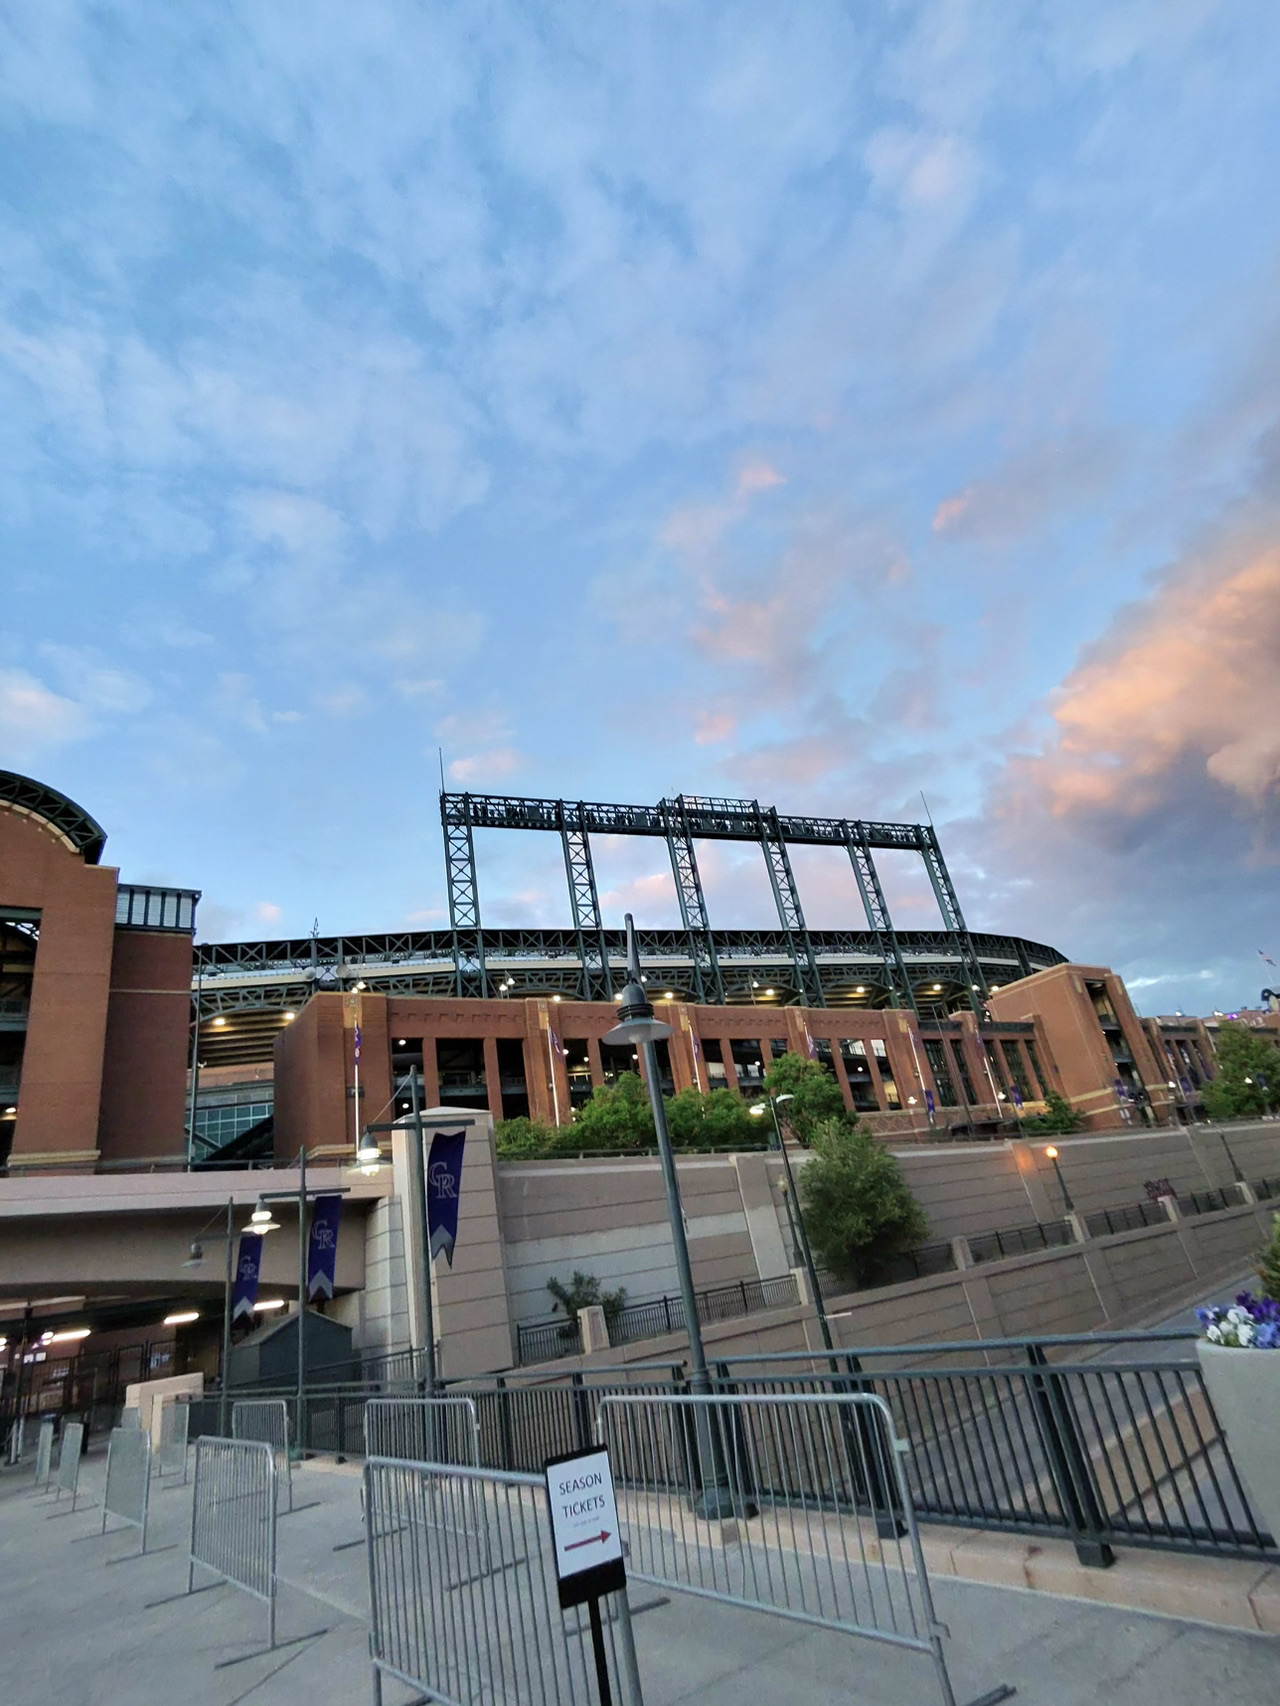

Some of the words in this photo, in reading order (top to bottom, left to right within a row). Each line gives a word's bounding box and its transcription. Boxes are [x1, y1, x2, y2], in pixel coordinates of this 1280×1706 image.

[428, 1161, 457, 1199] CR
[558, 1472, 602, 1496] SEASON
[562, 1494, 605, 1519] TICKETS
